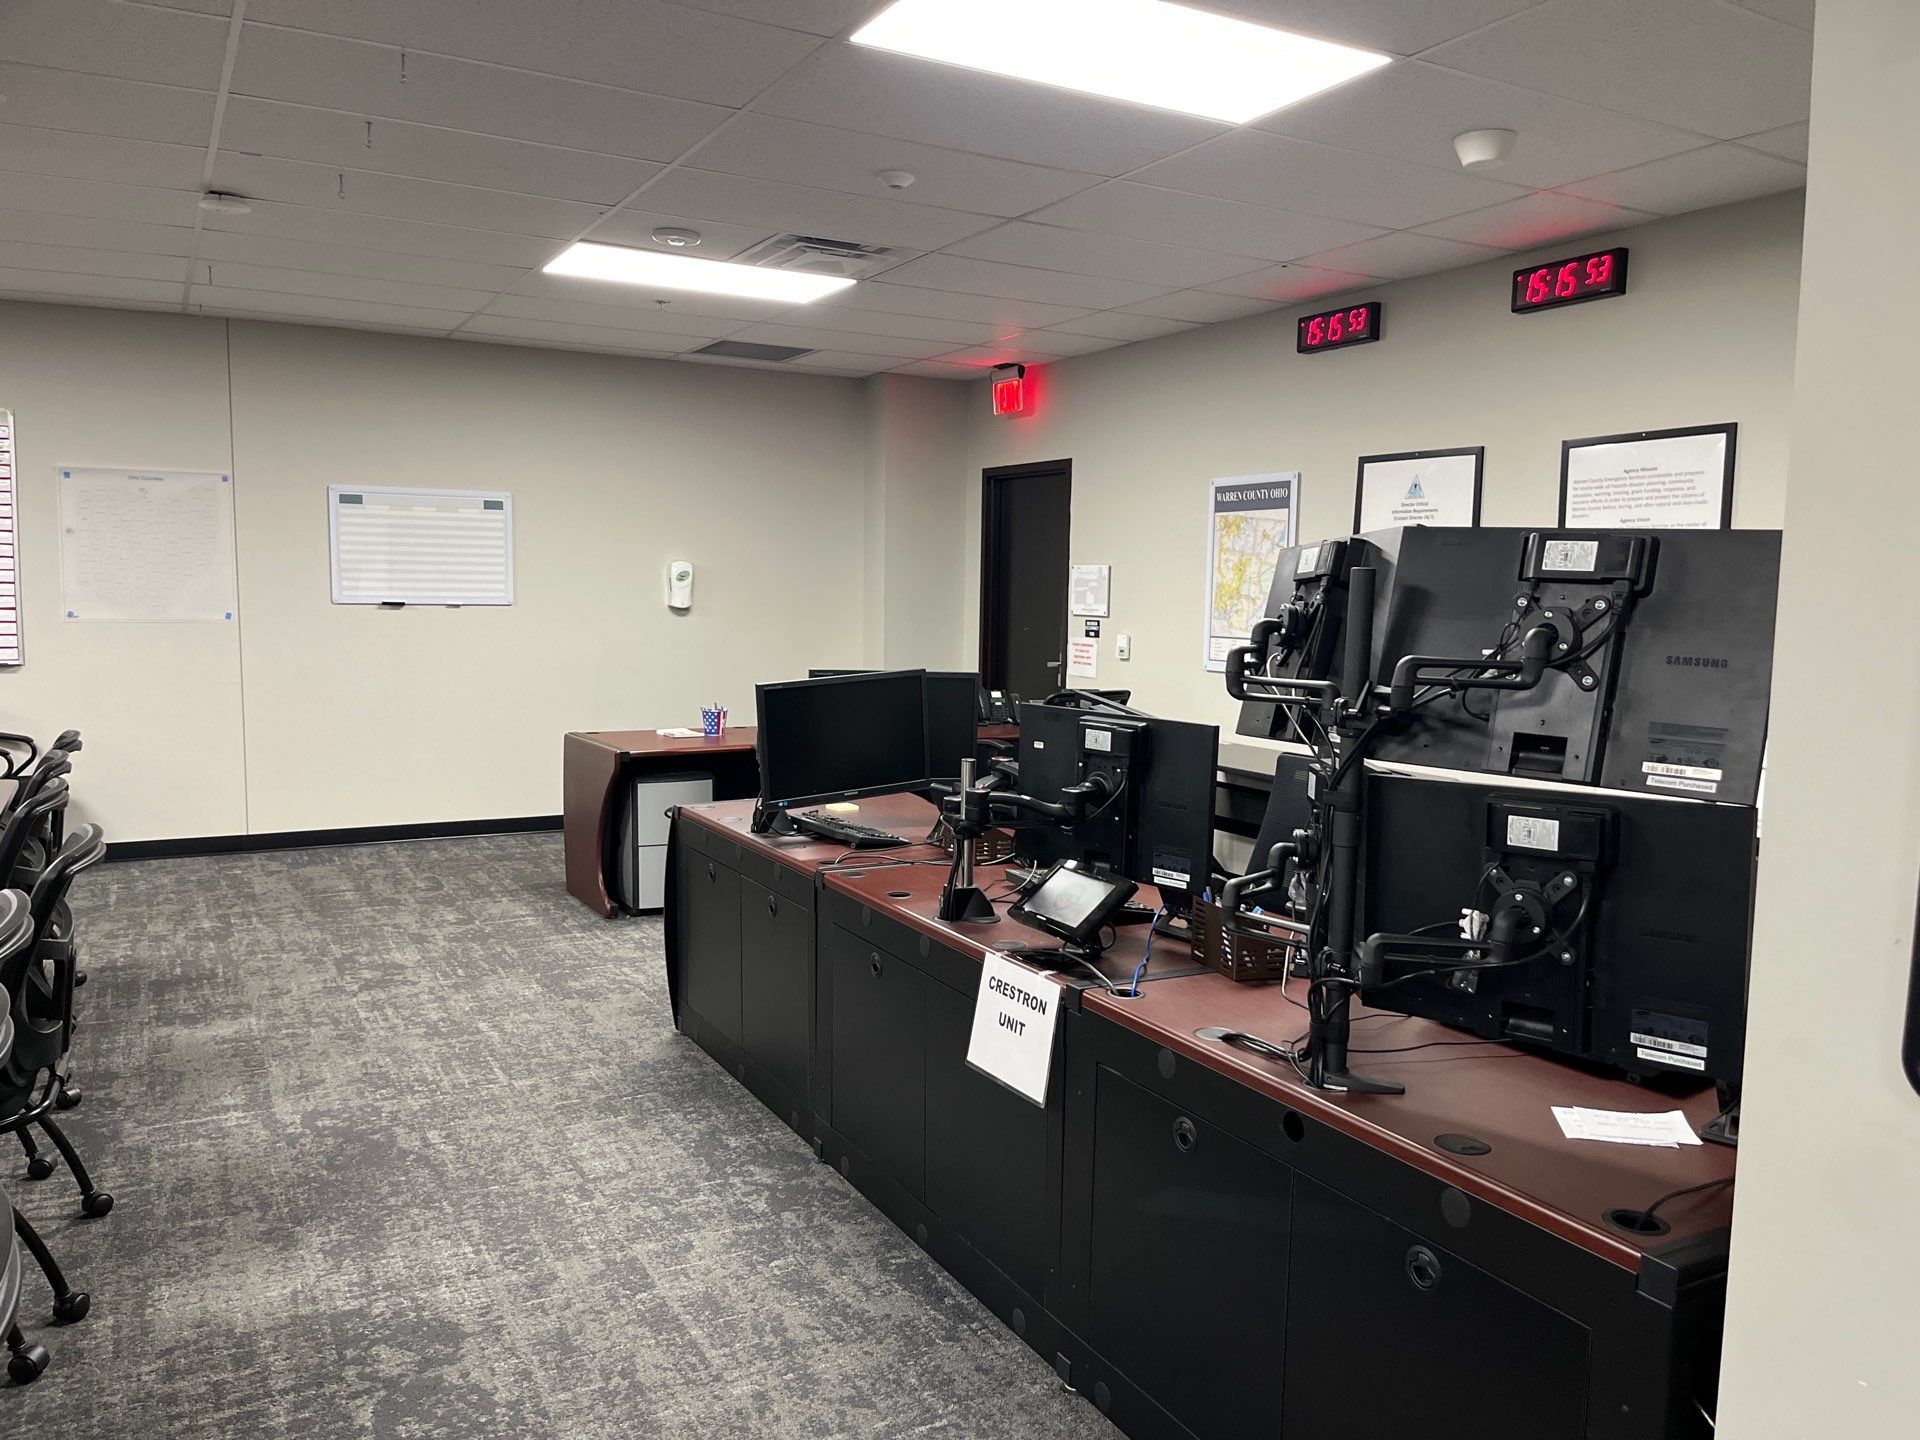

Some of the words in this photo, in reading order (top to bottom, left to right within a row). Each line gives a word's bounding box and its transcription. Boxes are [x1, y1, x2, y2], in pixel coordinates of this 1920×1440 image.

[1584, 255, 1613, 285] 53
[1348, 308, 1368, 333] 53
[1216, 492, 1242, 502] WARREN
[1243, 489, 1268, 500] COUNTY
[1270, 488, 1288, 498] OHIO
[1666, 656, 1728, 668] SAMSUNG
[989, 976, 1047, 1015] CRESTRON
[999, 1012, 1026, 1036] UNIT
